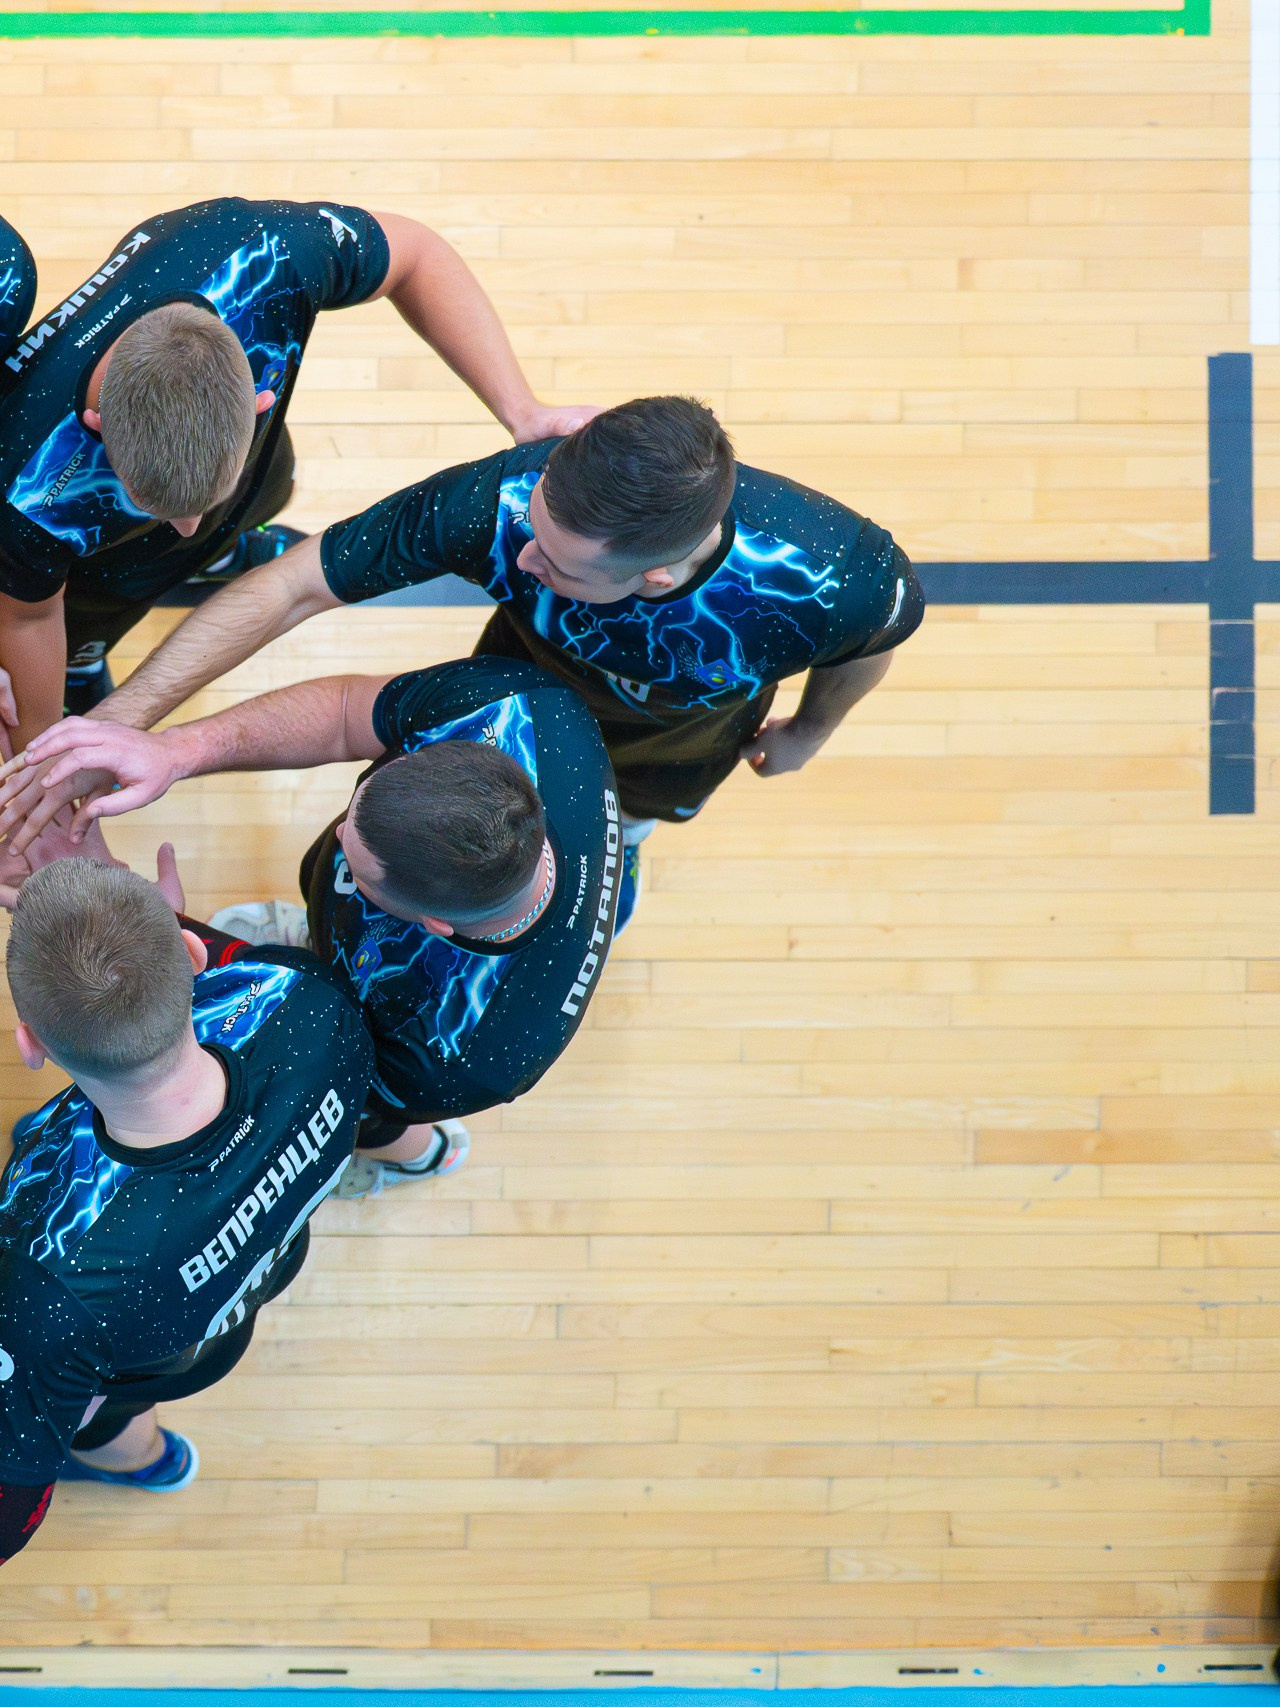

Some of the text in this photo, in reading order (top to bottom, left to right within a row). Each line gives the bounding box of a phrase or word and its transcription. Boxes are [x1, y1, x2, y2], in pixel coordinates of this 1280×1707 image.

[5, 232, 151, 373] КОШКИН
[74, 305, 121, 348] PATRICK
[50, 453, 87, 496] PATRICK
[561, 788, 619, 1017] ПОТАПОВ
[573, 854, 588, 915] PATRICK
[219, 1115, 255, 1163] PATRICK
[179, 1088, 345, 1293] ВЕПРЕНЦЕВ
